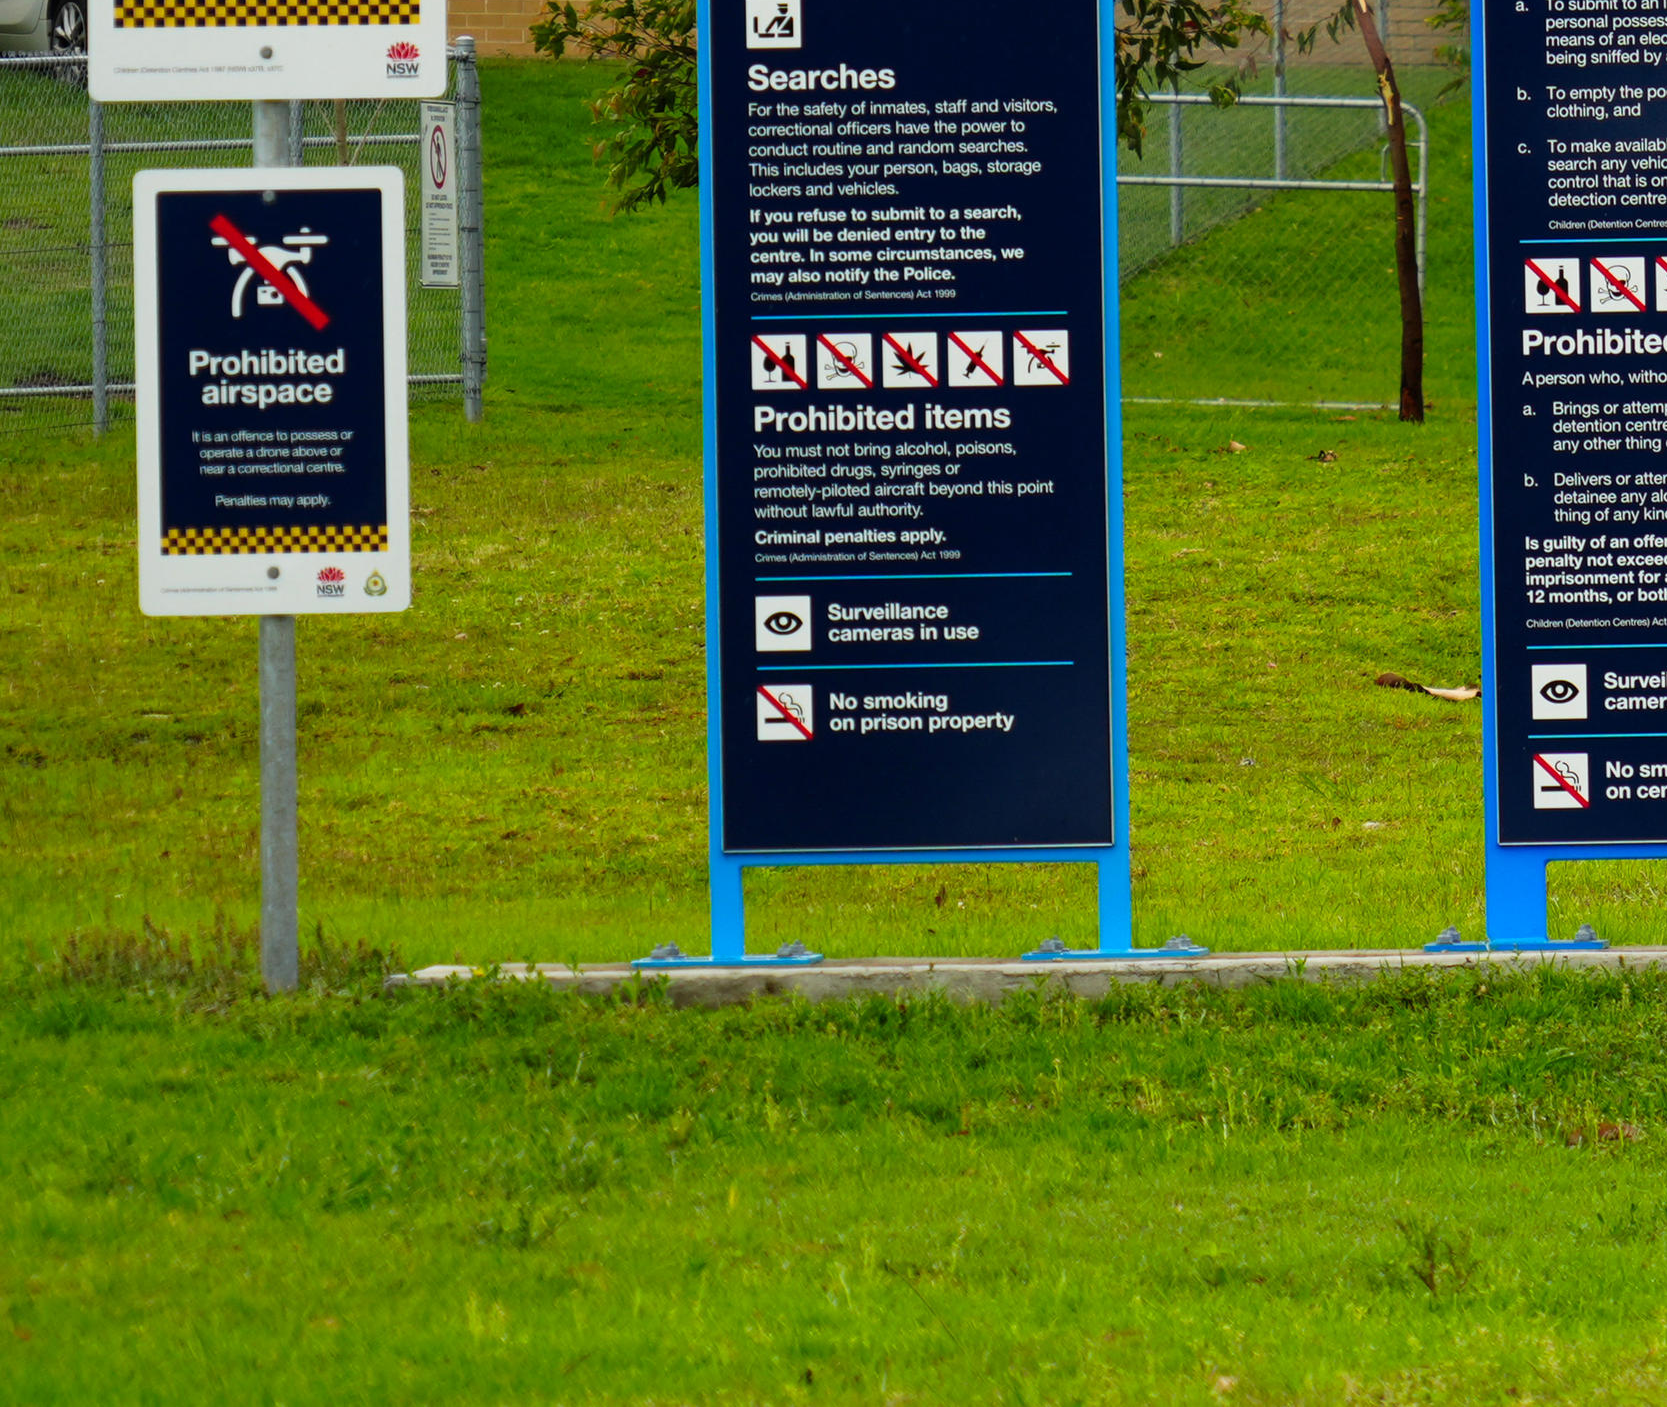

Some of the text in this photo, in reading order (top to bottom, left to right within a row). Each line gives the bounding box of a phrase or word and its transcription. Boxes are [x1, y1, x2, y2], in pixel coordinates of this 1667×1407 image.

[386, 63, 419, 75] NSW
[747, 63, 895, 91] Searches
[748, 98, 1057, 118] For the safety of inmates, staff and visitors,
[749, 204, 1021, 225] If you refuse to submit to a search,
[1548, 219, 1586, 229] Children
[1587, 219, 1633, 230] (Detention
[750, 291, 783, 301] Crimes
[784, 291, 851, 302] (Administration
[852, 290, 862, 299] of
[915, 289, 931, 298] Act
[934, 288, 956, 298] 1999
[189, 348, 344, 375] Prohibited
[201, 379, 333, 409] airspace
[754, 403, 1011, 432] Prohibited items
[191, 430, 353, 443] It is an offence to possess or
[199, 445, 343, 460] operate a drone above or
[199, 461, 345, 474] near a correctional centre.
[215, 493, 330, 507] Penalties may apply.
[754, 527, 946, 546] Criminal penalties apply.
[316, 584, 345, 595] NSW
[827, 602, 948, 620] Surveillance
[828, 623, 979, 642] cameras in use
[829, 691, 947, 714] No smoking
[829, 709, 1014, 734] on prison property
[1605, 760, 1634, 778] No
[1605, 785, 1631, 799] on
